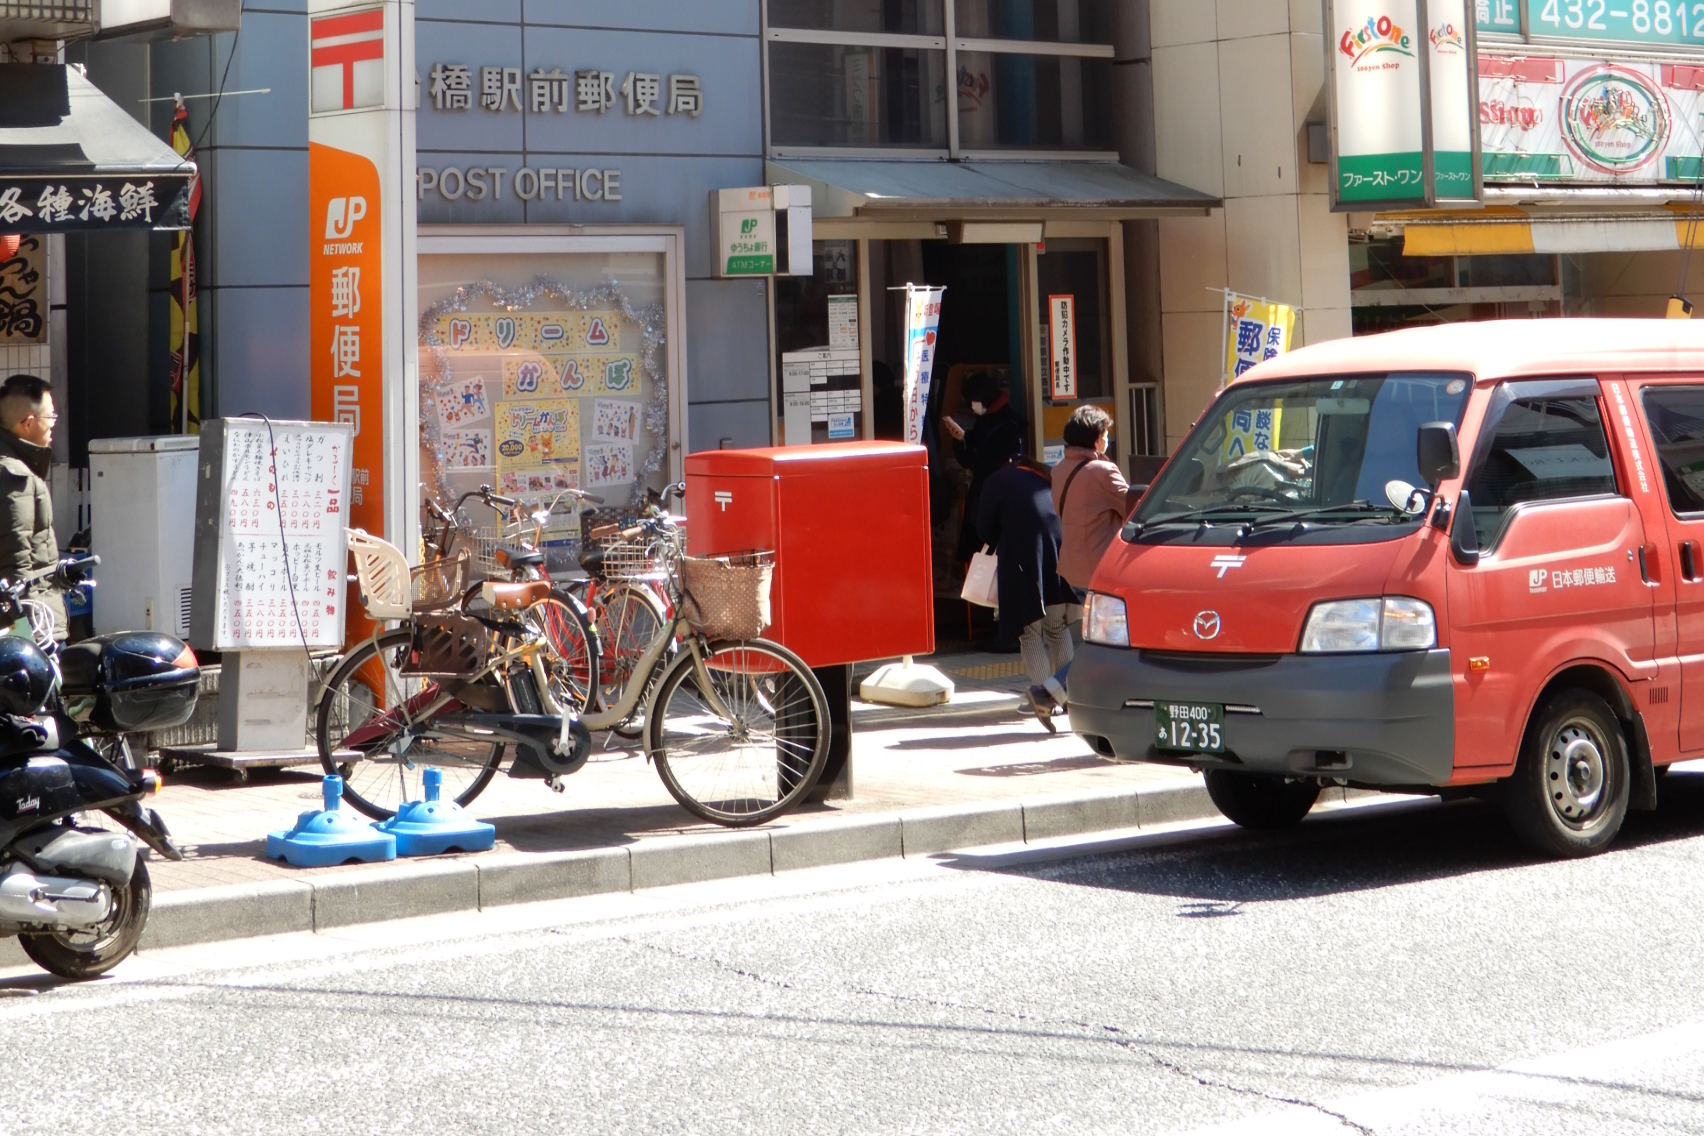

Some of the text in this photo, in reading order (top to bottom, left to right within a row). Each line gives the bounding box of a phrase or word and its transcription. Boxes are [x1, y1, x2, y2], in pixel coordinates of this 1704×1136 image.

[415, 63, 704, 118] 橋駅前郵便局
[419, 167, 622, 202] POST OFFICE
[0, 181, 159, 224] 各種海鮮
[323, 242, 363, 255] NETWORK
[450, 317, 609, 350] ドリーム
[331, 266, 362, 438] 郵便局
[516, 358, 632, 393] かんぽ
[1551, 565, 1617, 590] 日本郵便輸送
[1158, 720, 1221, 749] あ 12-35
